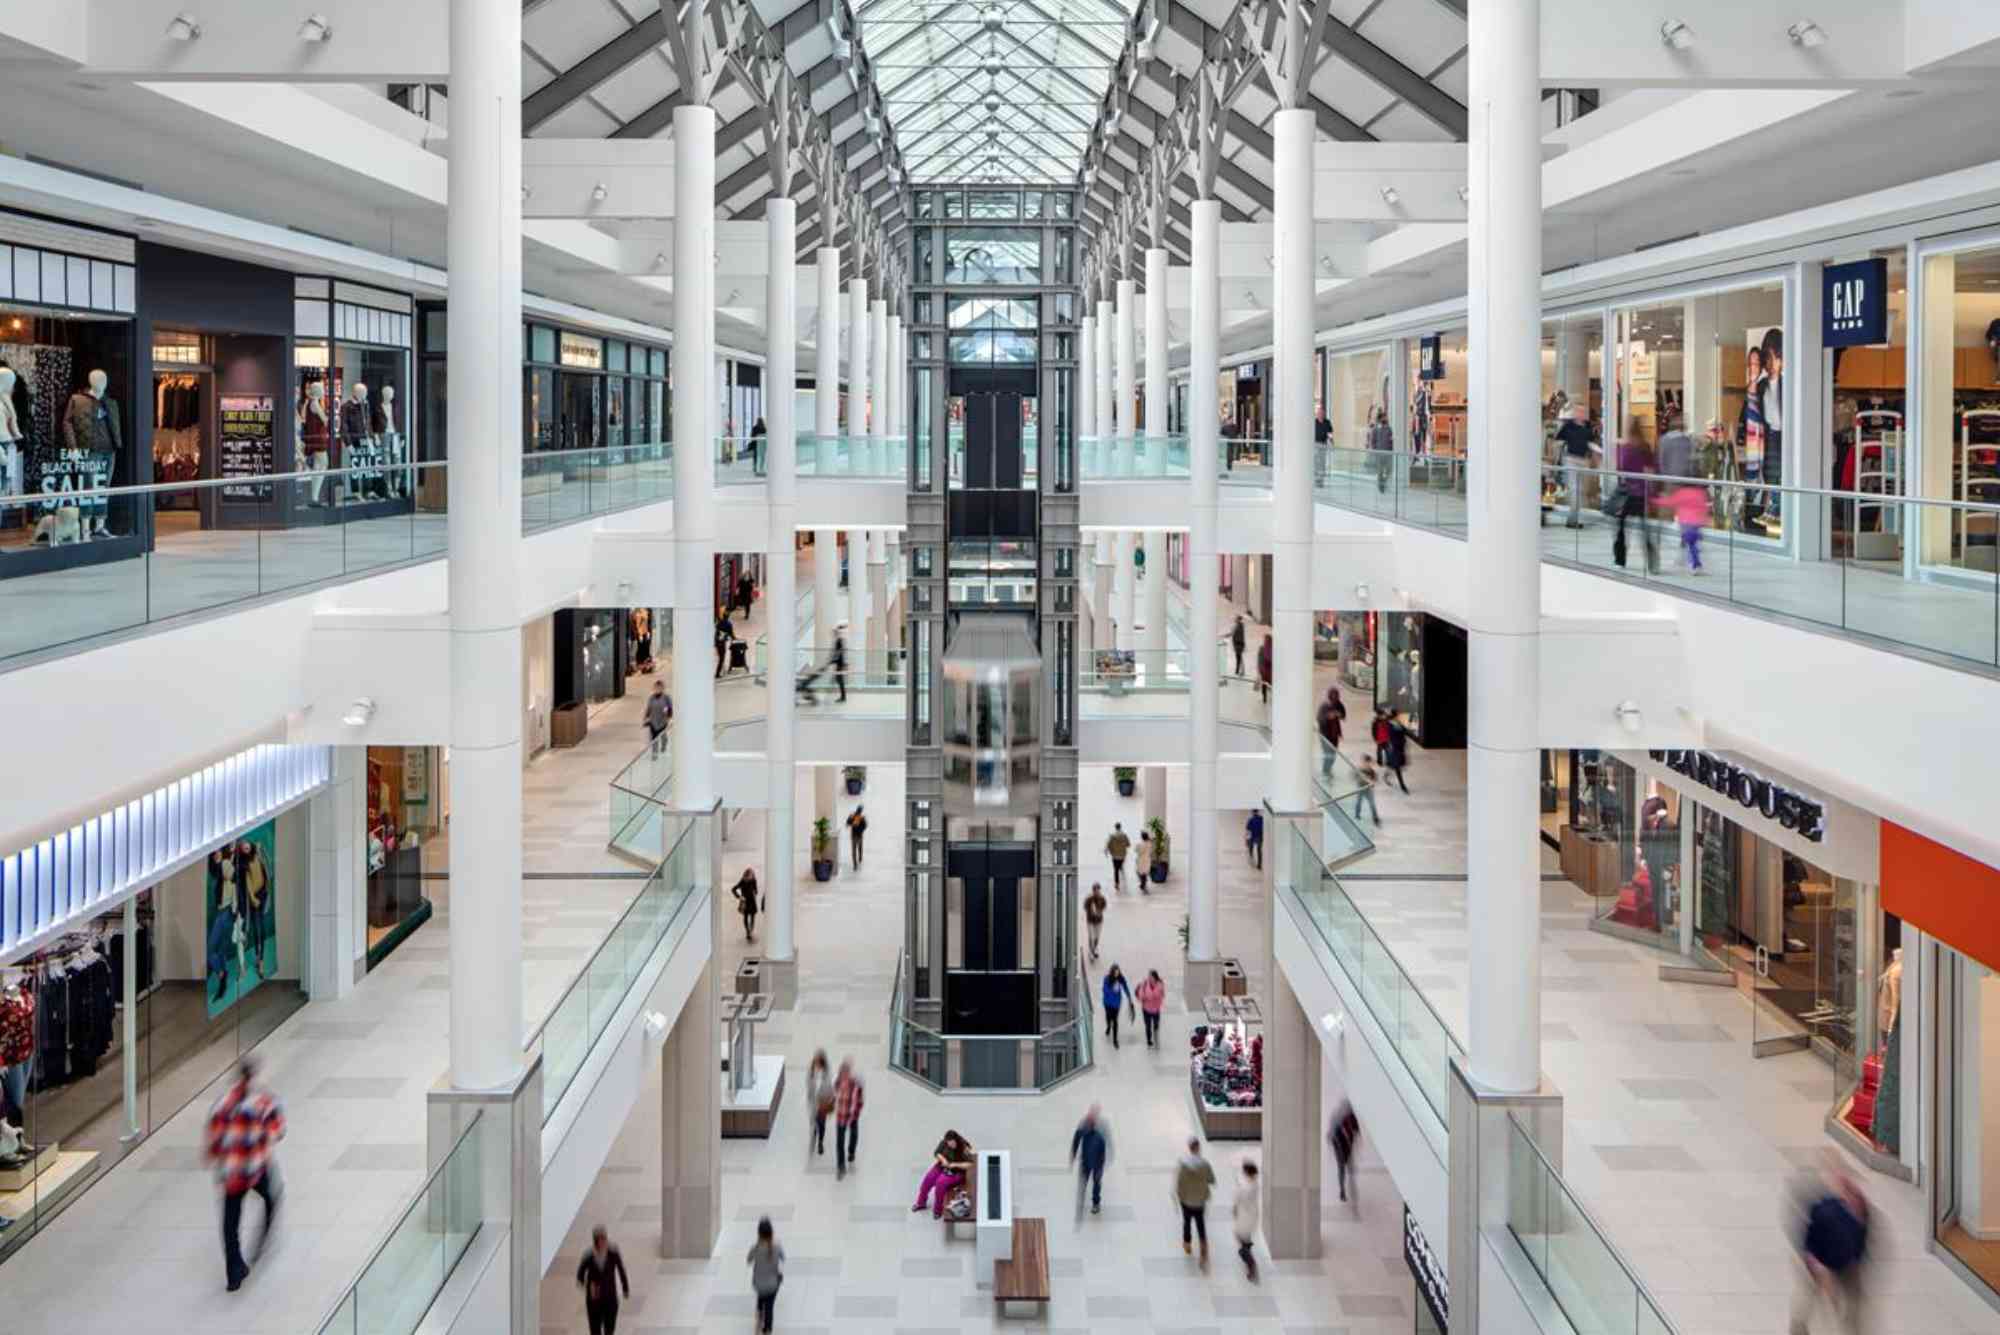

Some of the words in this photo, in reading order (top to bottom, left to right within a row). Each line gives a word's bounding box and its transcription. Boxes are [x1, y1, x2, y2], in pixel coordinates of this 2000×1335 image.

[1833, 279, 1864, 319] GAP
[41, 462, 72, 474] BLACK
[75, 461, 107, 473] FRIDAY
[351, 456, 384, 479] SALE
[41, 474, 107, 509] SALE
